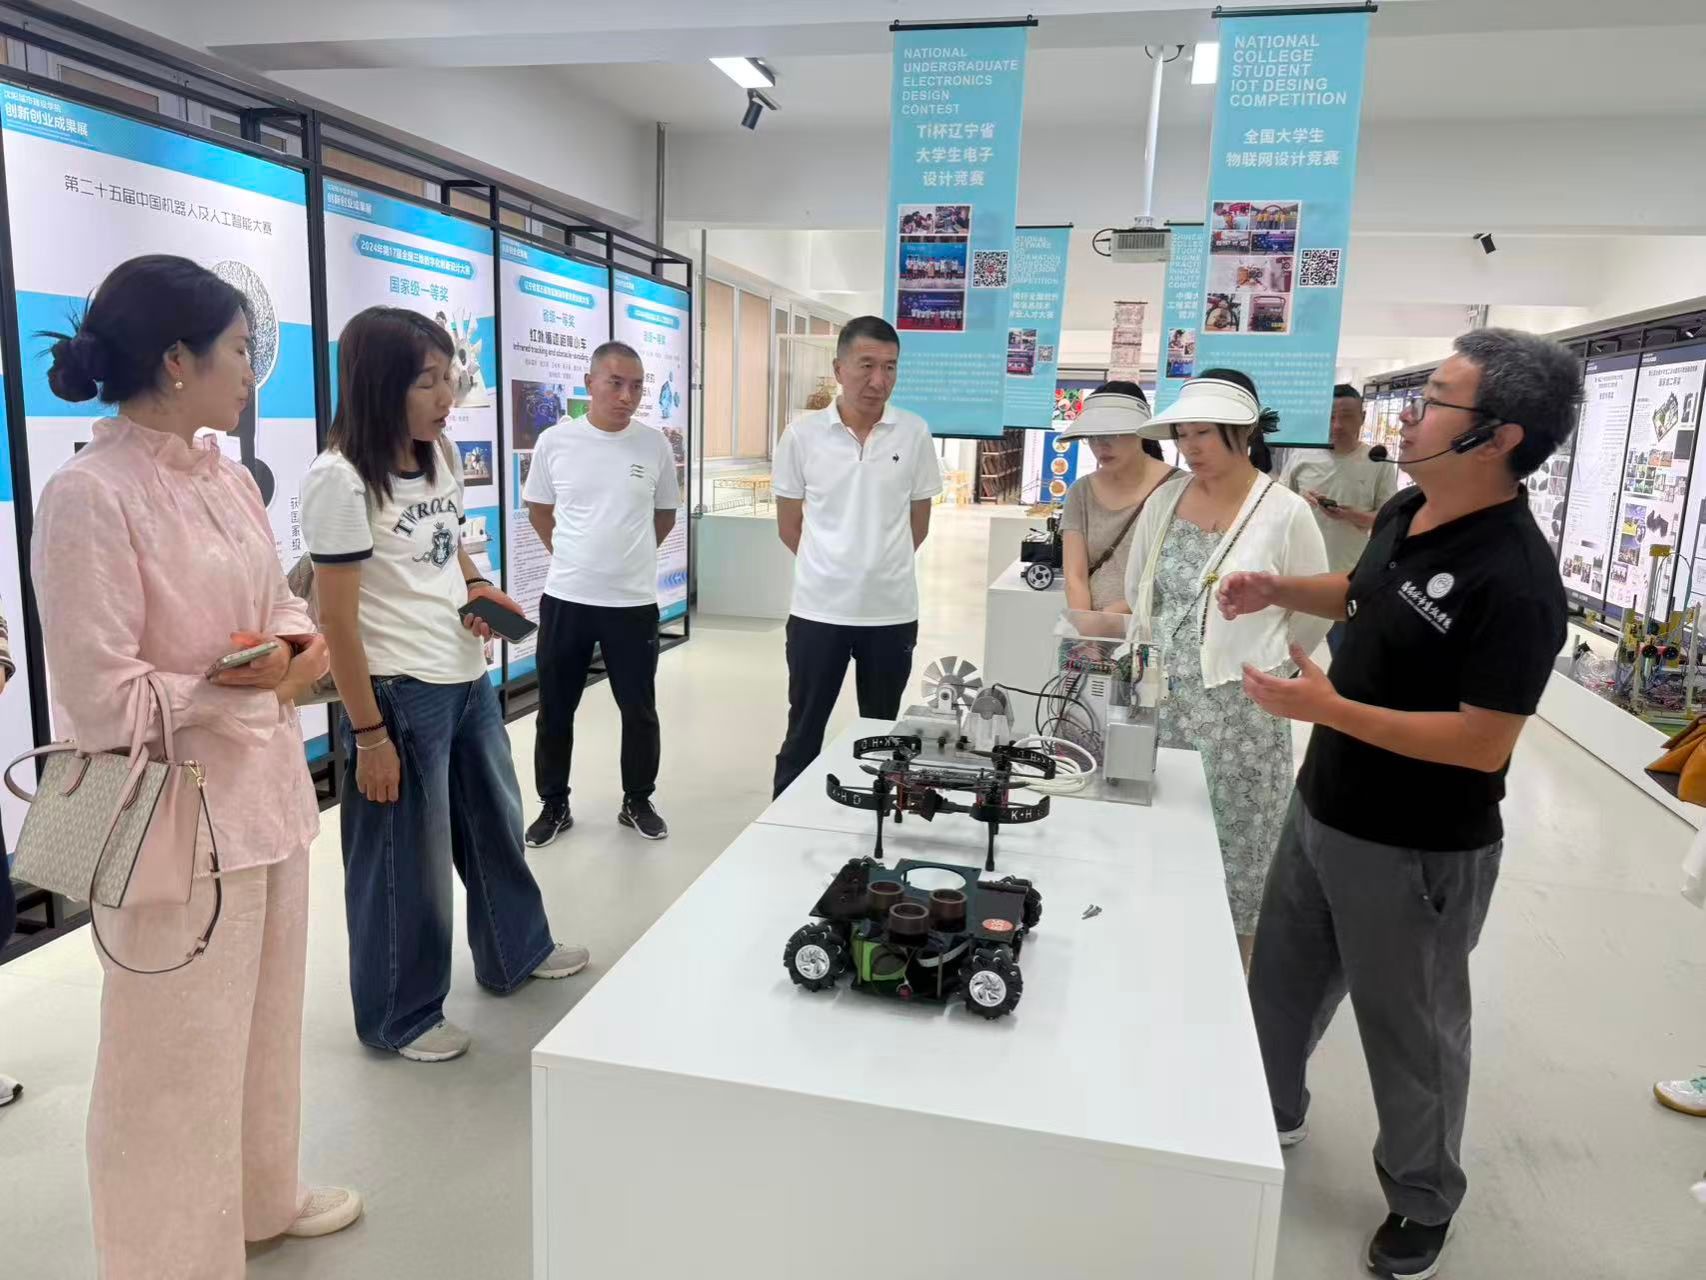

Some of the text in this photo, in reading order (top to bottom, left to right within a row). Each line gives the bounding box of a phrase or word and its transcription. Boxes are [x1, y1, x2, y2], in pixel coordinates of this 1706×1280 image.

[1234, 34, 1320, 49] NATIONAL
[903, 47, 968, 59] NATIONAL
[1233, 49, 1314, 63] COLLEGE
[903, 60, 1019, 73] UNDERGRADUATE
[1232, 63, 1312, 78] STUDENT
[903, 75, 993, 87] ELECTRONICS
[1231, 77, 1328, 93] IOT DESING
[902, 89, 950, 101] DESIGN
[1230, 91, 1347, 107] COMPETITION
[901, 104, 960, 115] CONTEST
[5, 102, 88, 137] 创新创业成果展
[1243, 128, 1325, 145] 全国大学生
[916, 147, 994, 163] 大学生电子
[1226, 150, 1341, 168] 物联网设计竞赛
[923, 170, 985, 187] 设计竞赛
[64, 173, 273, 236] 第二十五届中国机器人及人工智能大赛
[389, 275, 449, 302] 国家级一等奖
